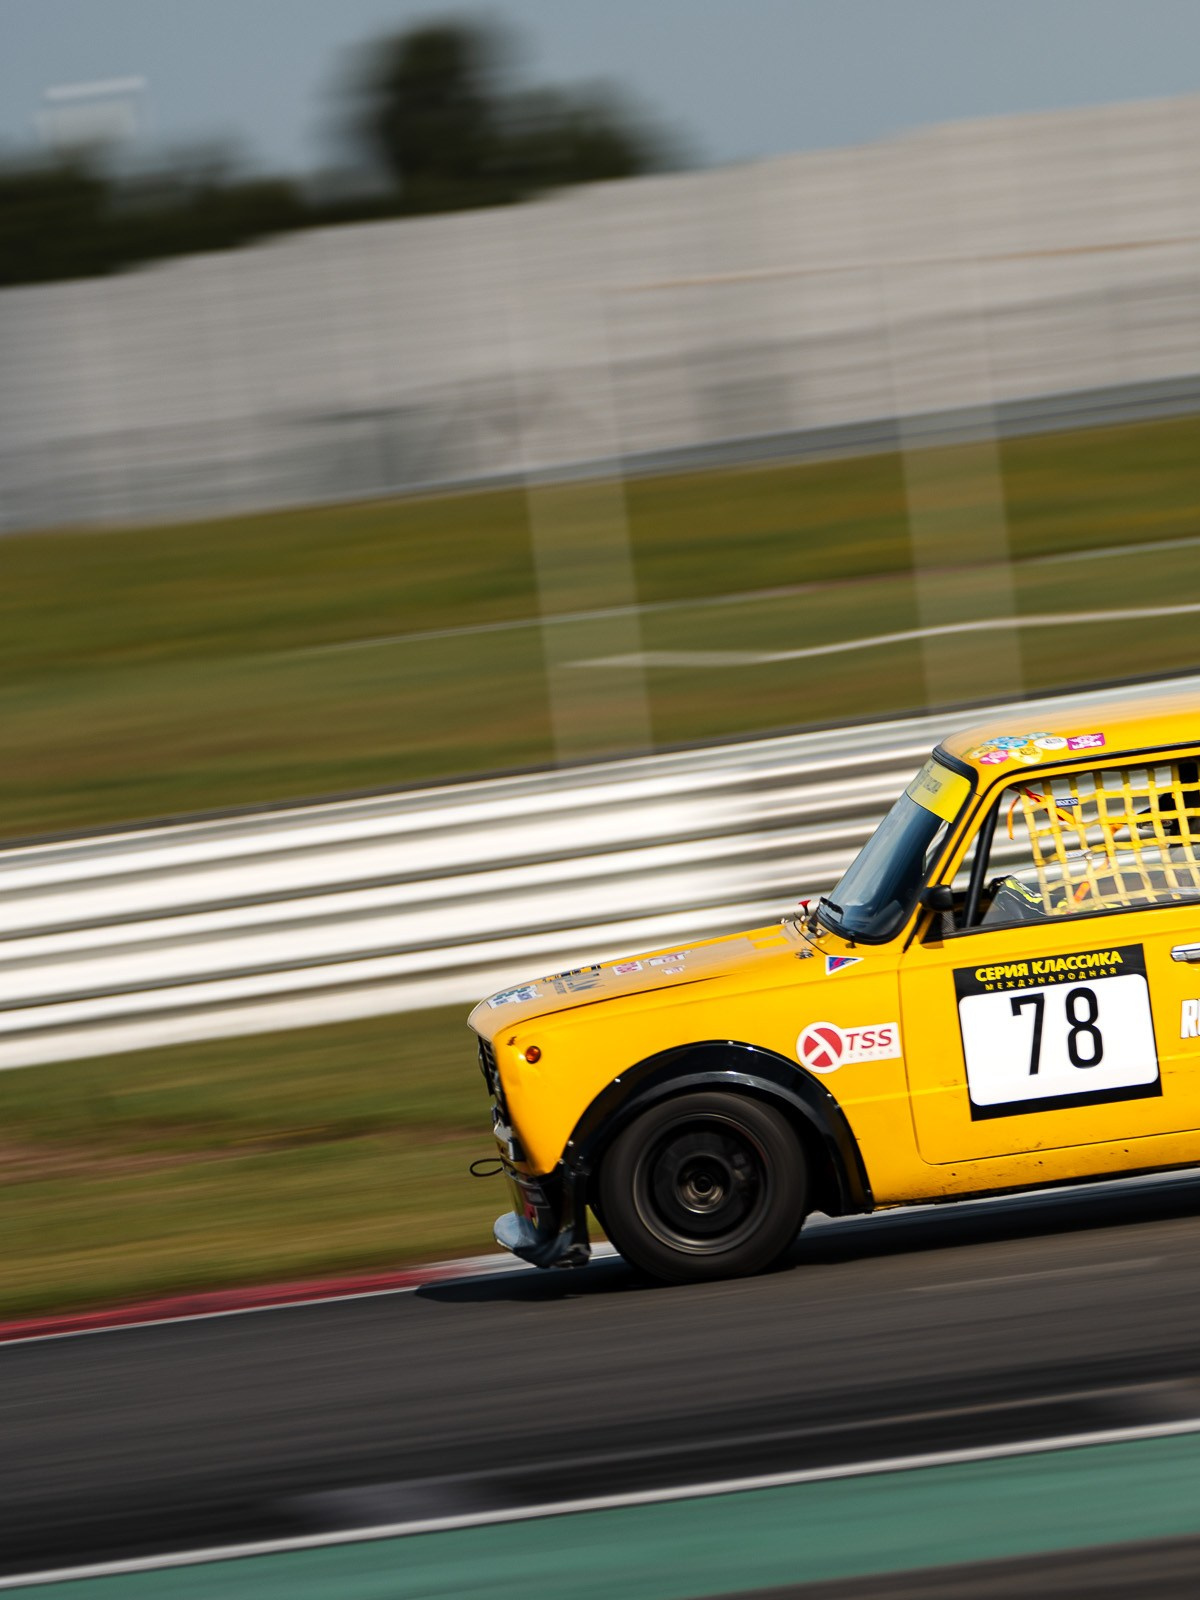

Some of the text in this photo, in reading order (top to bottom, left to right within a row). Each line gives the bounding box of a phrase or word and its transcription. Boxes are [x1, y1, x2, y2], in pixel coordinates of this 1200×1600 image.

[974, 950, 1124, 982] СЕРИЯ КЛАССИКА
[985, 967, 1118, 991] МЕЖДУНАРОДНАЯ
[845, 1029, 892, 1051] TSS
[1009, 986, 1104, 1076] 78
